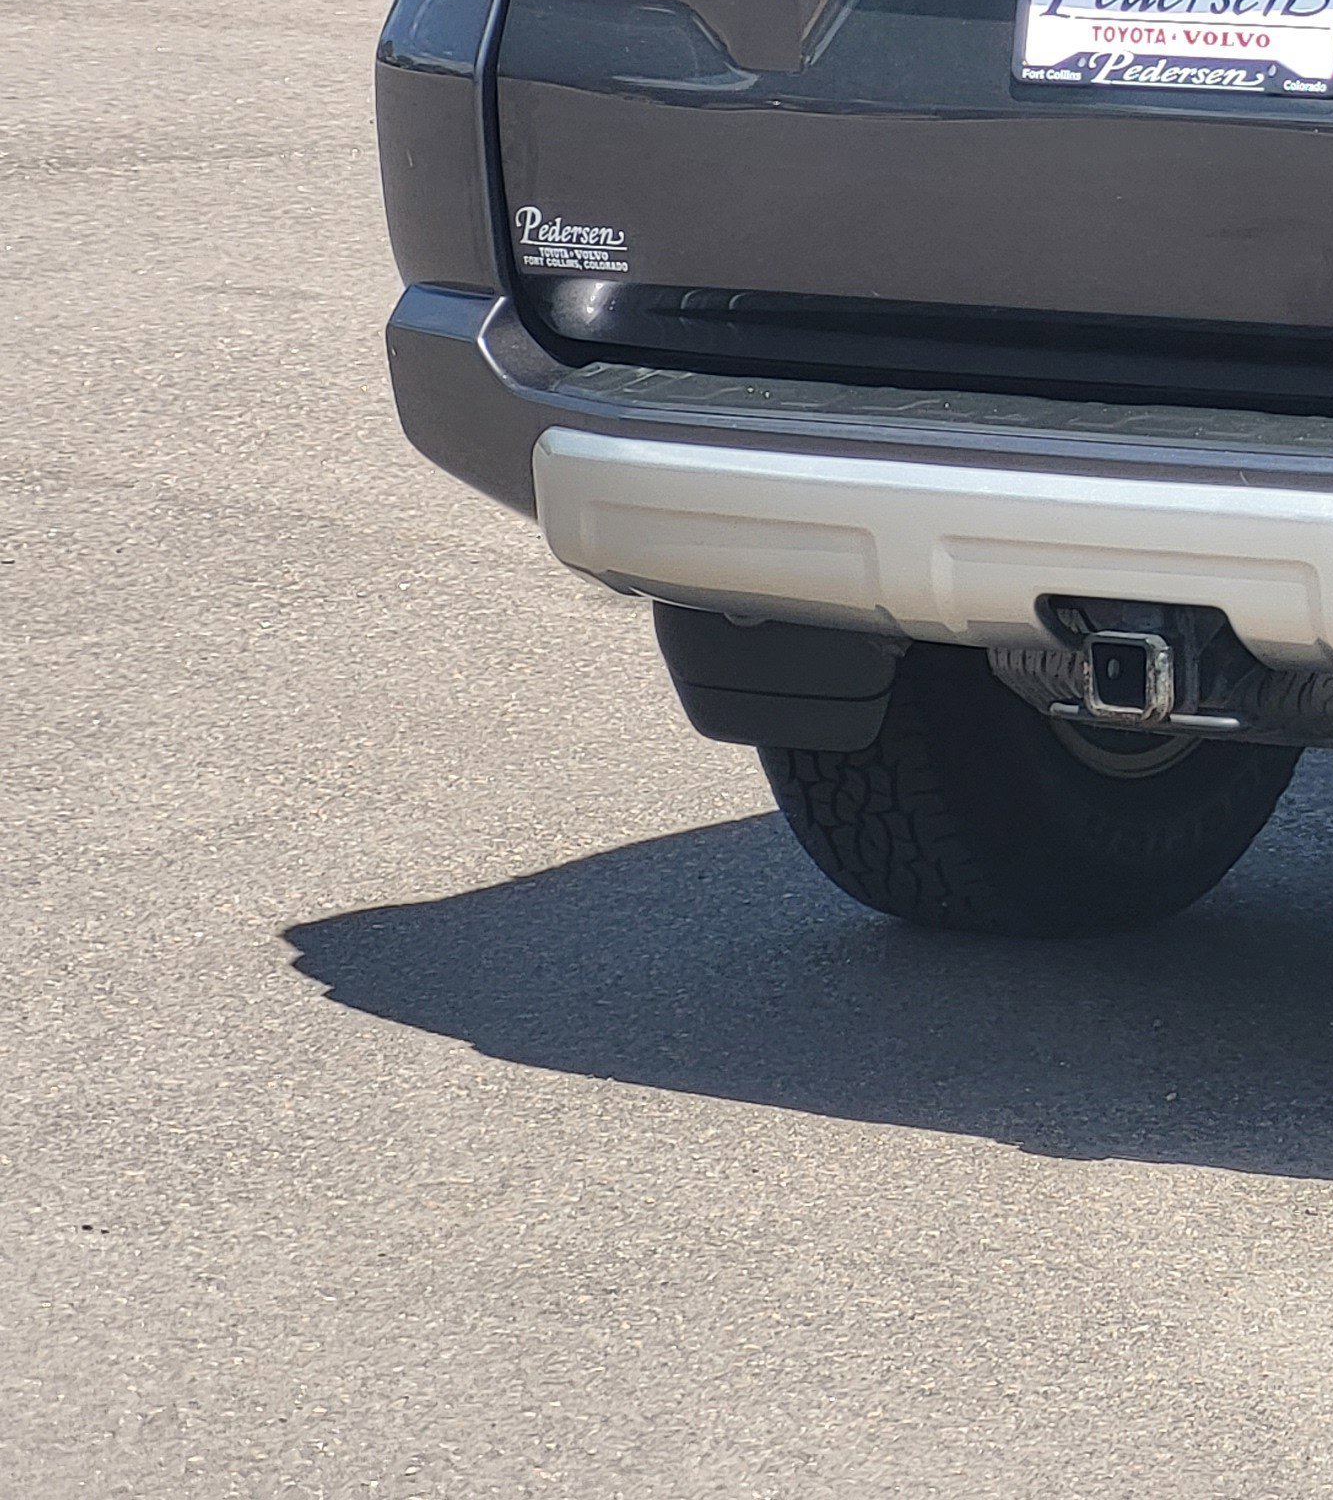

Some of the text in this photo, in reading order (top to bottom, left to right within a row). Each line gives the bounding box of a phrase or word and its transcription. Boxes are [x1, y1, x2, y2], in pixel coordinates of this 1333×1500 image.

[1091, 25, 1271, 49] TOYOTA VOLVO
[1022, 68, 1082, 81] Fort Collins
[1087, 50, 1265, 87] Pedersen
[1283, 79, 1327, 93] Colorado
[515, 206, 625, 246] Pedersen
[538, 247, 609, 261] TOYOTA VOLVO
[523, 255, 544, 267] FORT
[583, 260, 629, 273] COLORADO
